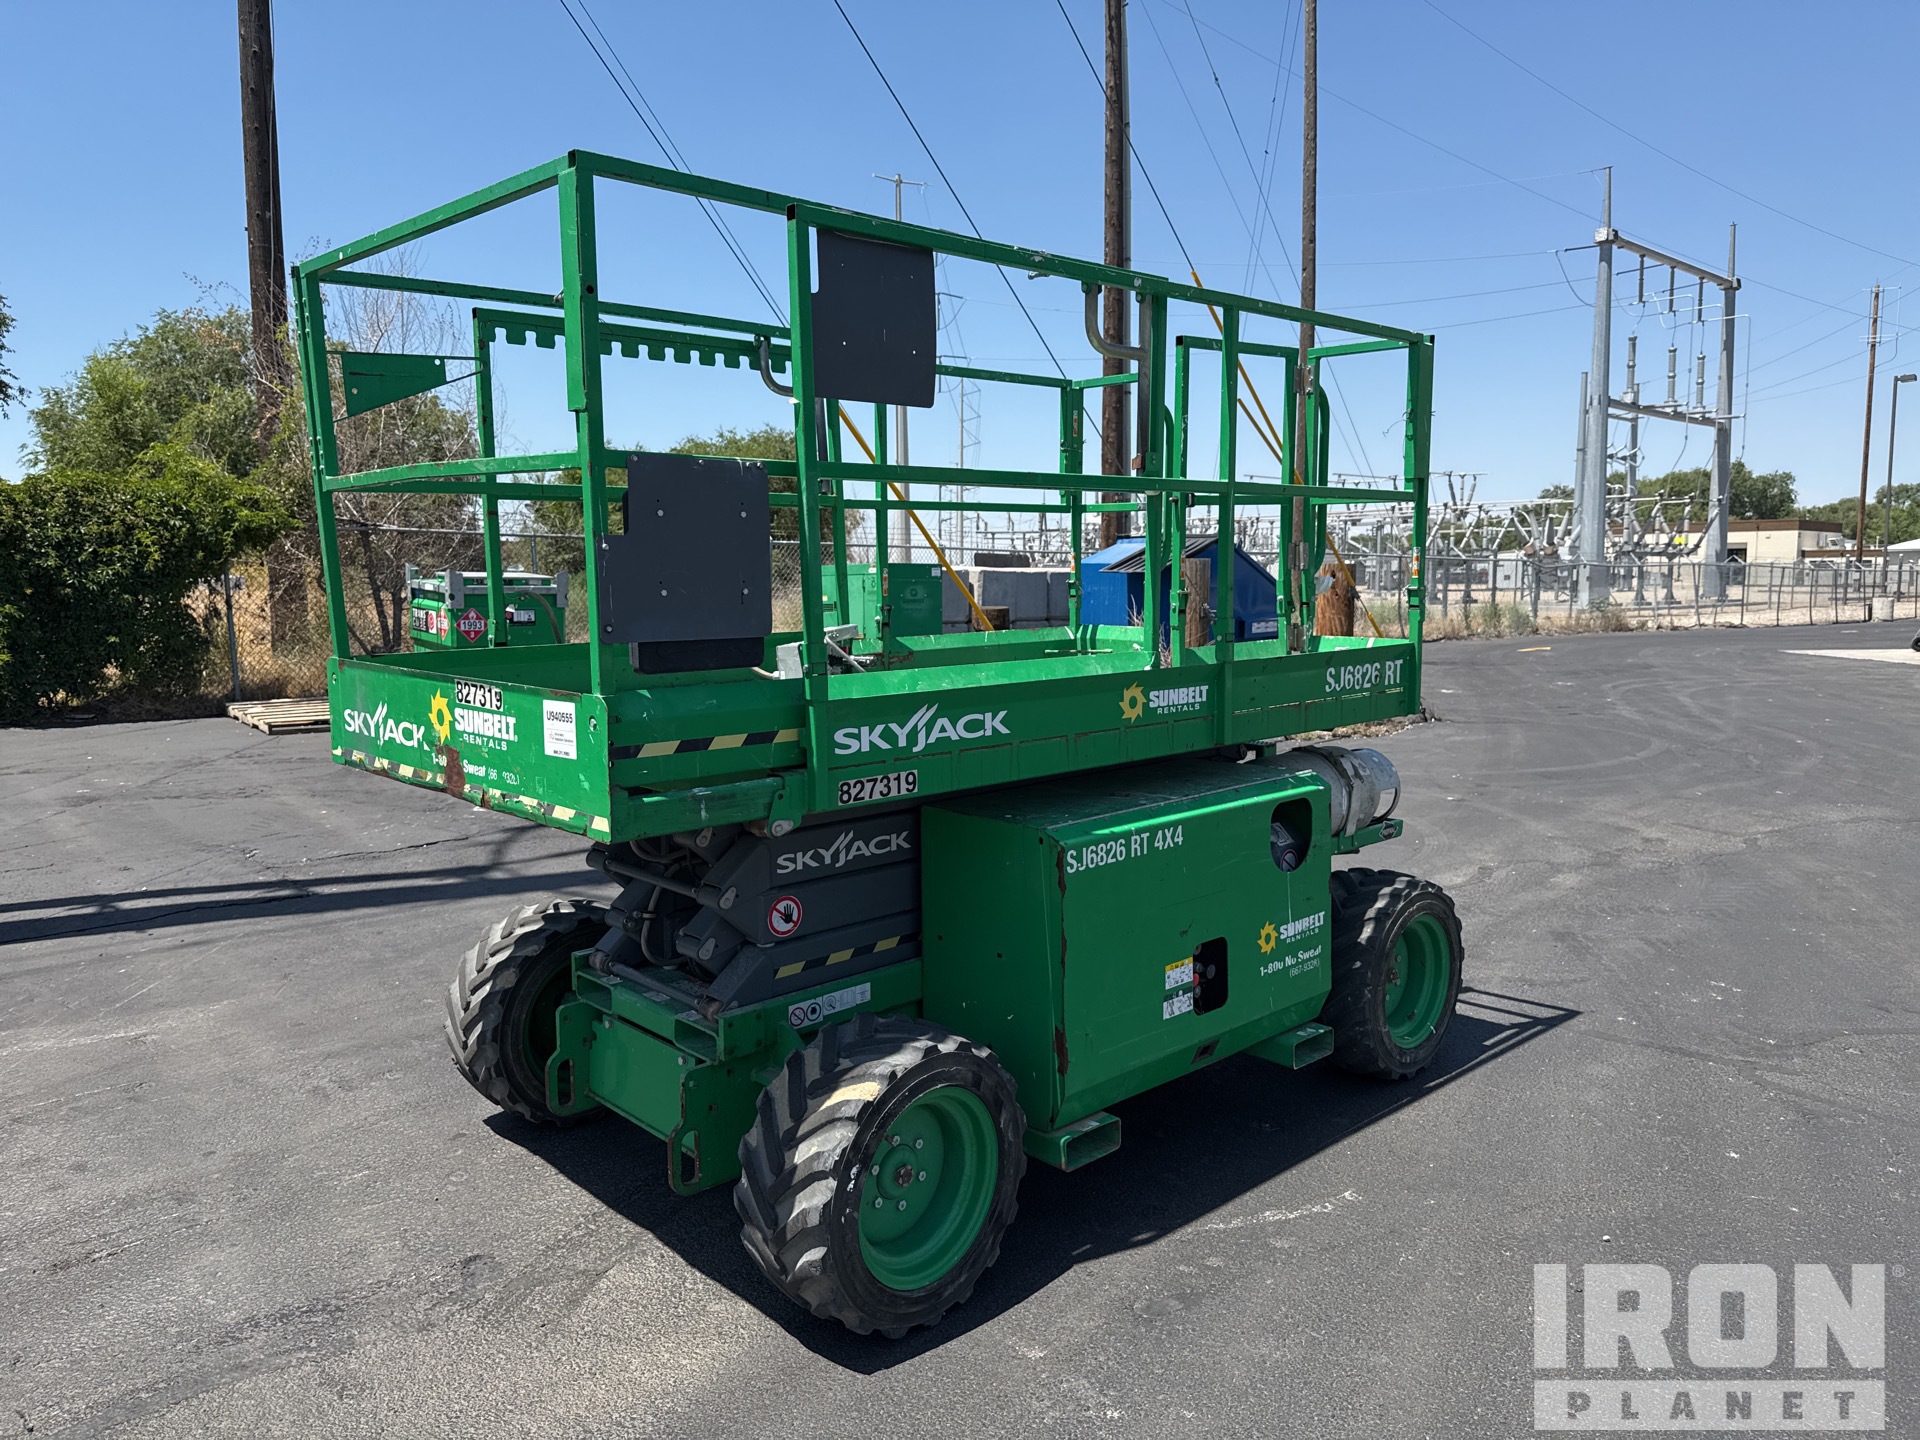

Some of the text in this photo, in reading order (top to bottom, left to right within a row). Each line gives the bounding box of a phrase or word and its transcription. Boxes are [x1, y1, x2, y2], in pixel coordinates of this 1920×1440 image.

[462, 621, 482, 629] 1993
[1325, 659, 1403, 692] SJ6826 RT
[456, 680, 502, 710] 827319
[1148, 685, 1208, 708] SUNBELT
[1157, 703, 1200, 714] RENTALS
[344, 701, 430, 751] SKYJACK
[454, 708, 517, 741] SUNBELT
[834, 703, 1011, 755] SKYJACK
[463, 733, 507, 750] RENTALS
[463, 759, 486, 777] Sweat
[839, 771, 917, 804] 827319
[776, 830, 912, 874] SKYJACK
[1066, 824, 1184, 874] SJ6826 RT 4X4
[1280, 911, 1325, 939] SUNBELT
